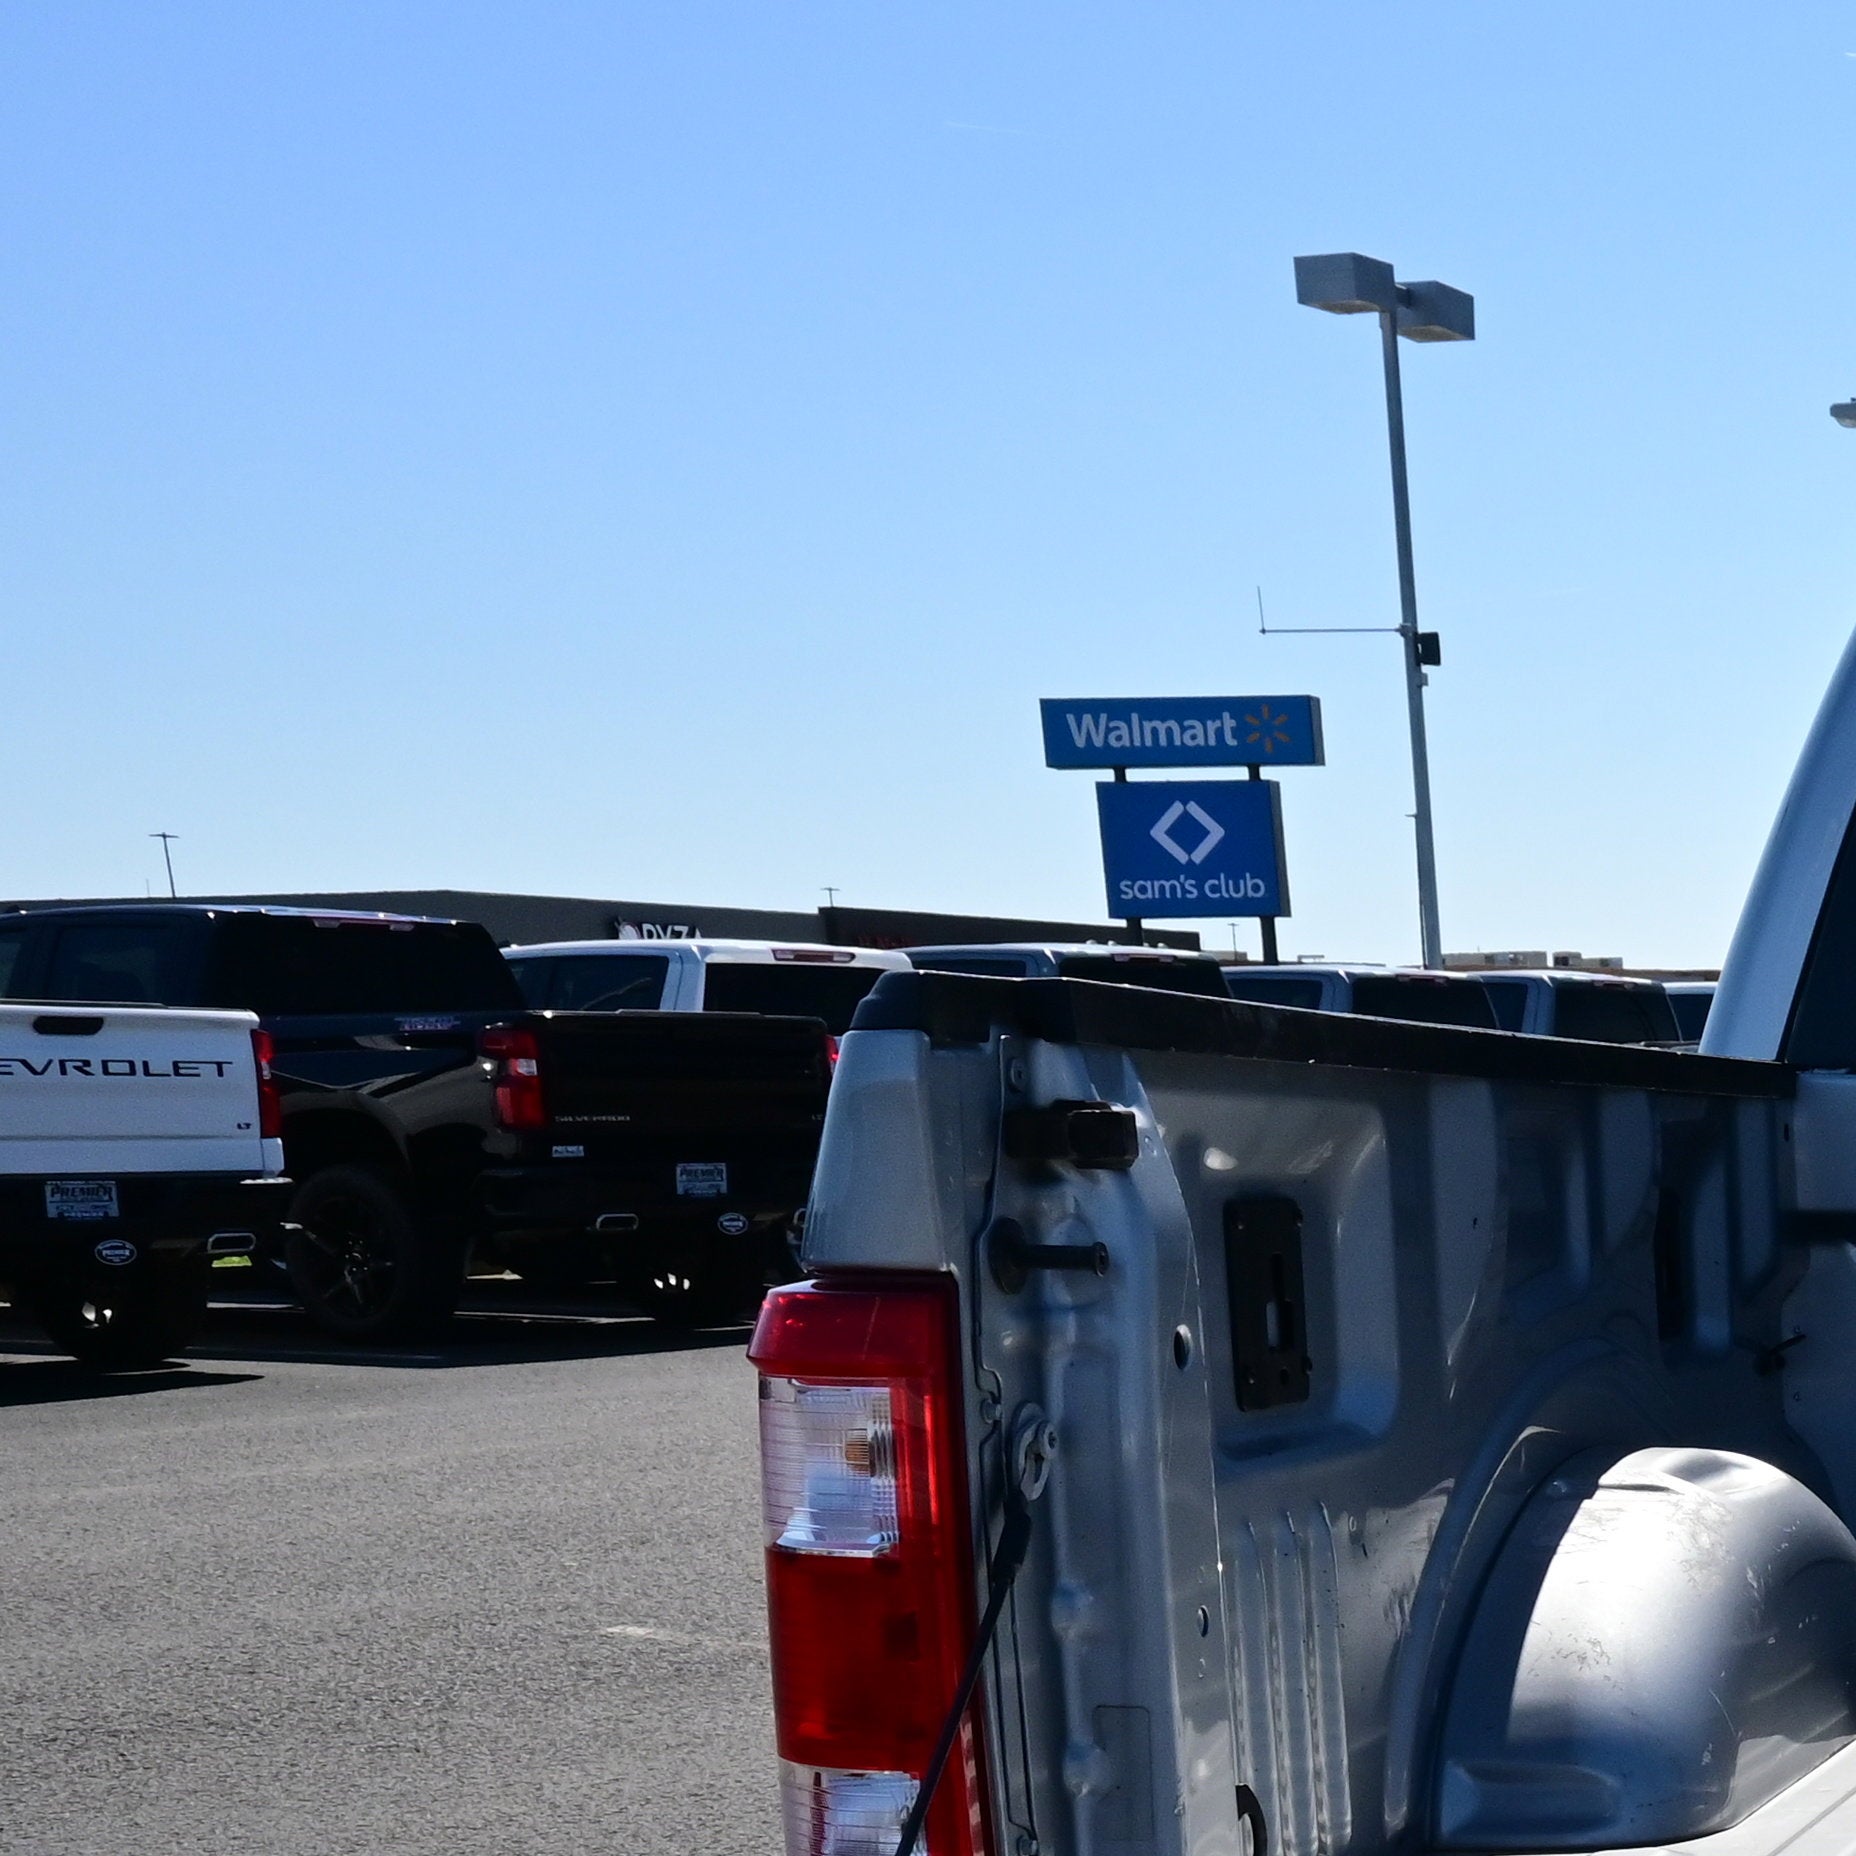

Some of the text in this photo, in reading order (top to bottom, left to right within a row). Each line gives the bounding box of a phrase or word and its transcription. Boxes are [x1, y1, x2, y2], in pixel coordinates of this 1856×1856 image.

[1066, 711, 1238, 748] Walmart
[1119, 872, 1266, 900] sam's club
[50, 1184, 114, 1202] PREMIER
